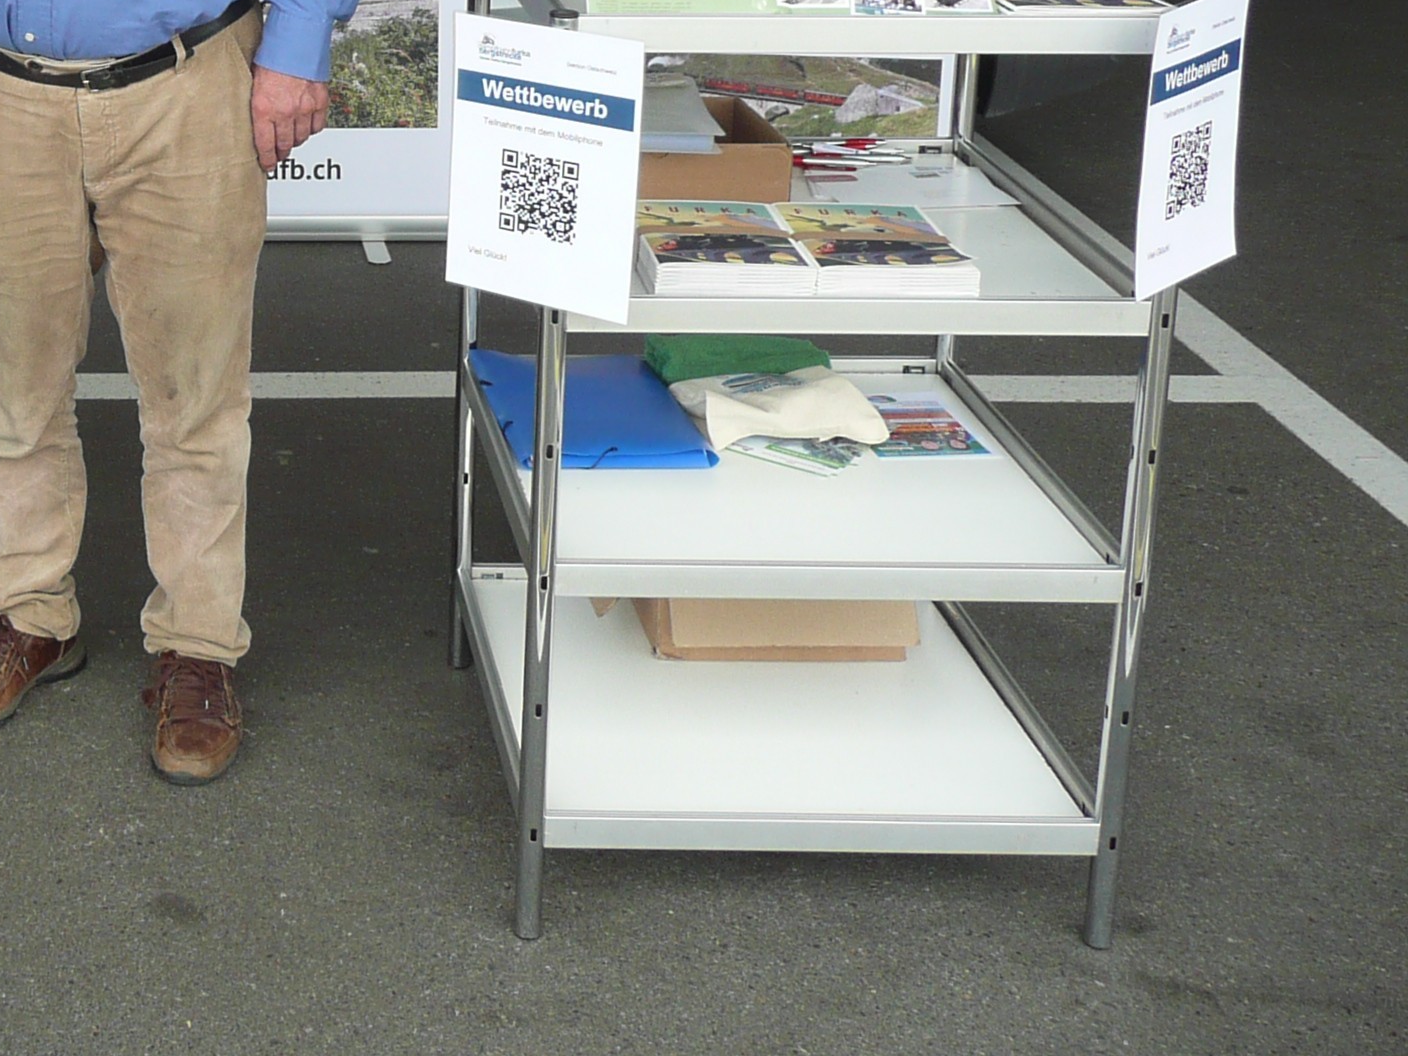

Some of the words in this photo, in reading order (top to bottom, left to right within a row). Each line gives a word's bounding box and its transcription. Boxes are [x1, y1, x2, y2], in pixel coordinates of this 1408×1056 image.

[1165, 50, 1229, 92] Wettbewerb
[482, 78, 608, 119] Wettbewerb
[483, 116, 523, 132] Teilnahme
[538, 128, 555, 138] dem
[267, 158, 341, 180] dfb.ch
